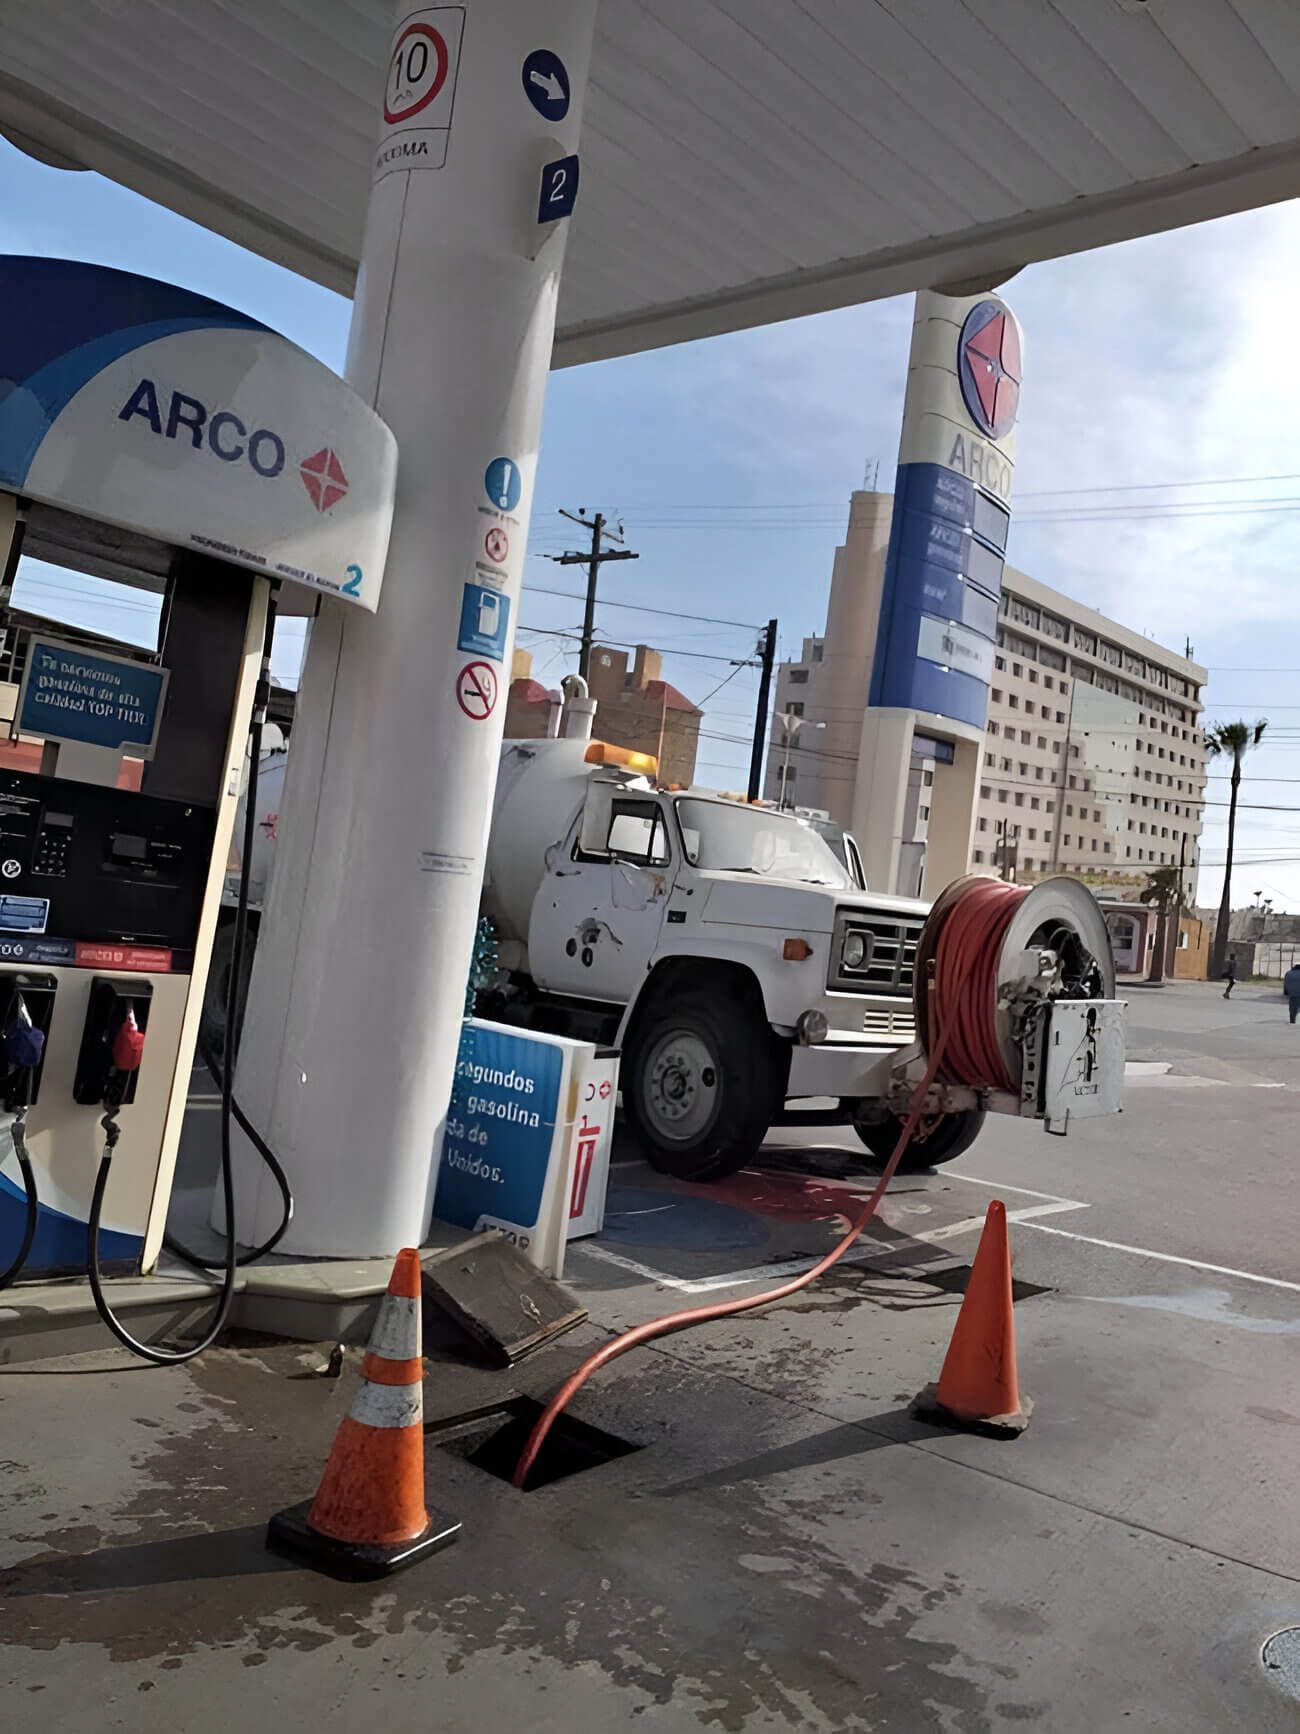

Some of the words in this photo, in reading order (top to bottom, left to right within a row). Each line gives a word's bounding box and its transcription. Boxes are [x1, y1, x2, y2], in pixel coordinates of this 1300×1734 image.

[395, 41, 428, 90] 10
[549, 169, 567, 202] 2
[117, 378, 286, 478] ARCO
[949, 433, 1011, 499] ARCO
[341, 564, 363, 598] 2
[467, 1095, 540, 1128] gasolina
[468, 1123, 488, 1146] de
